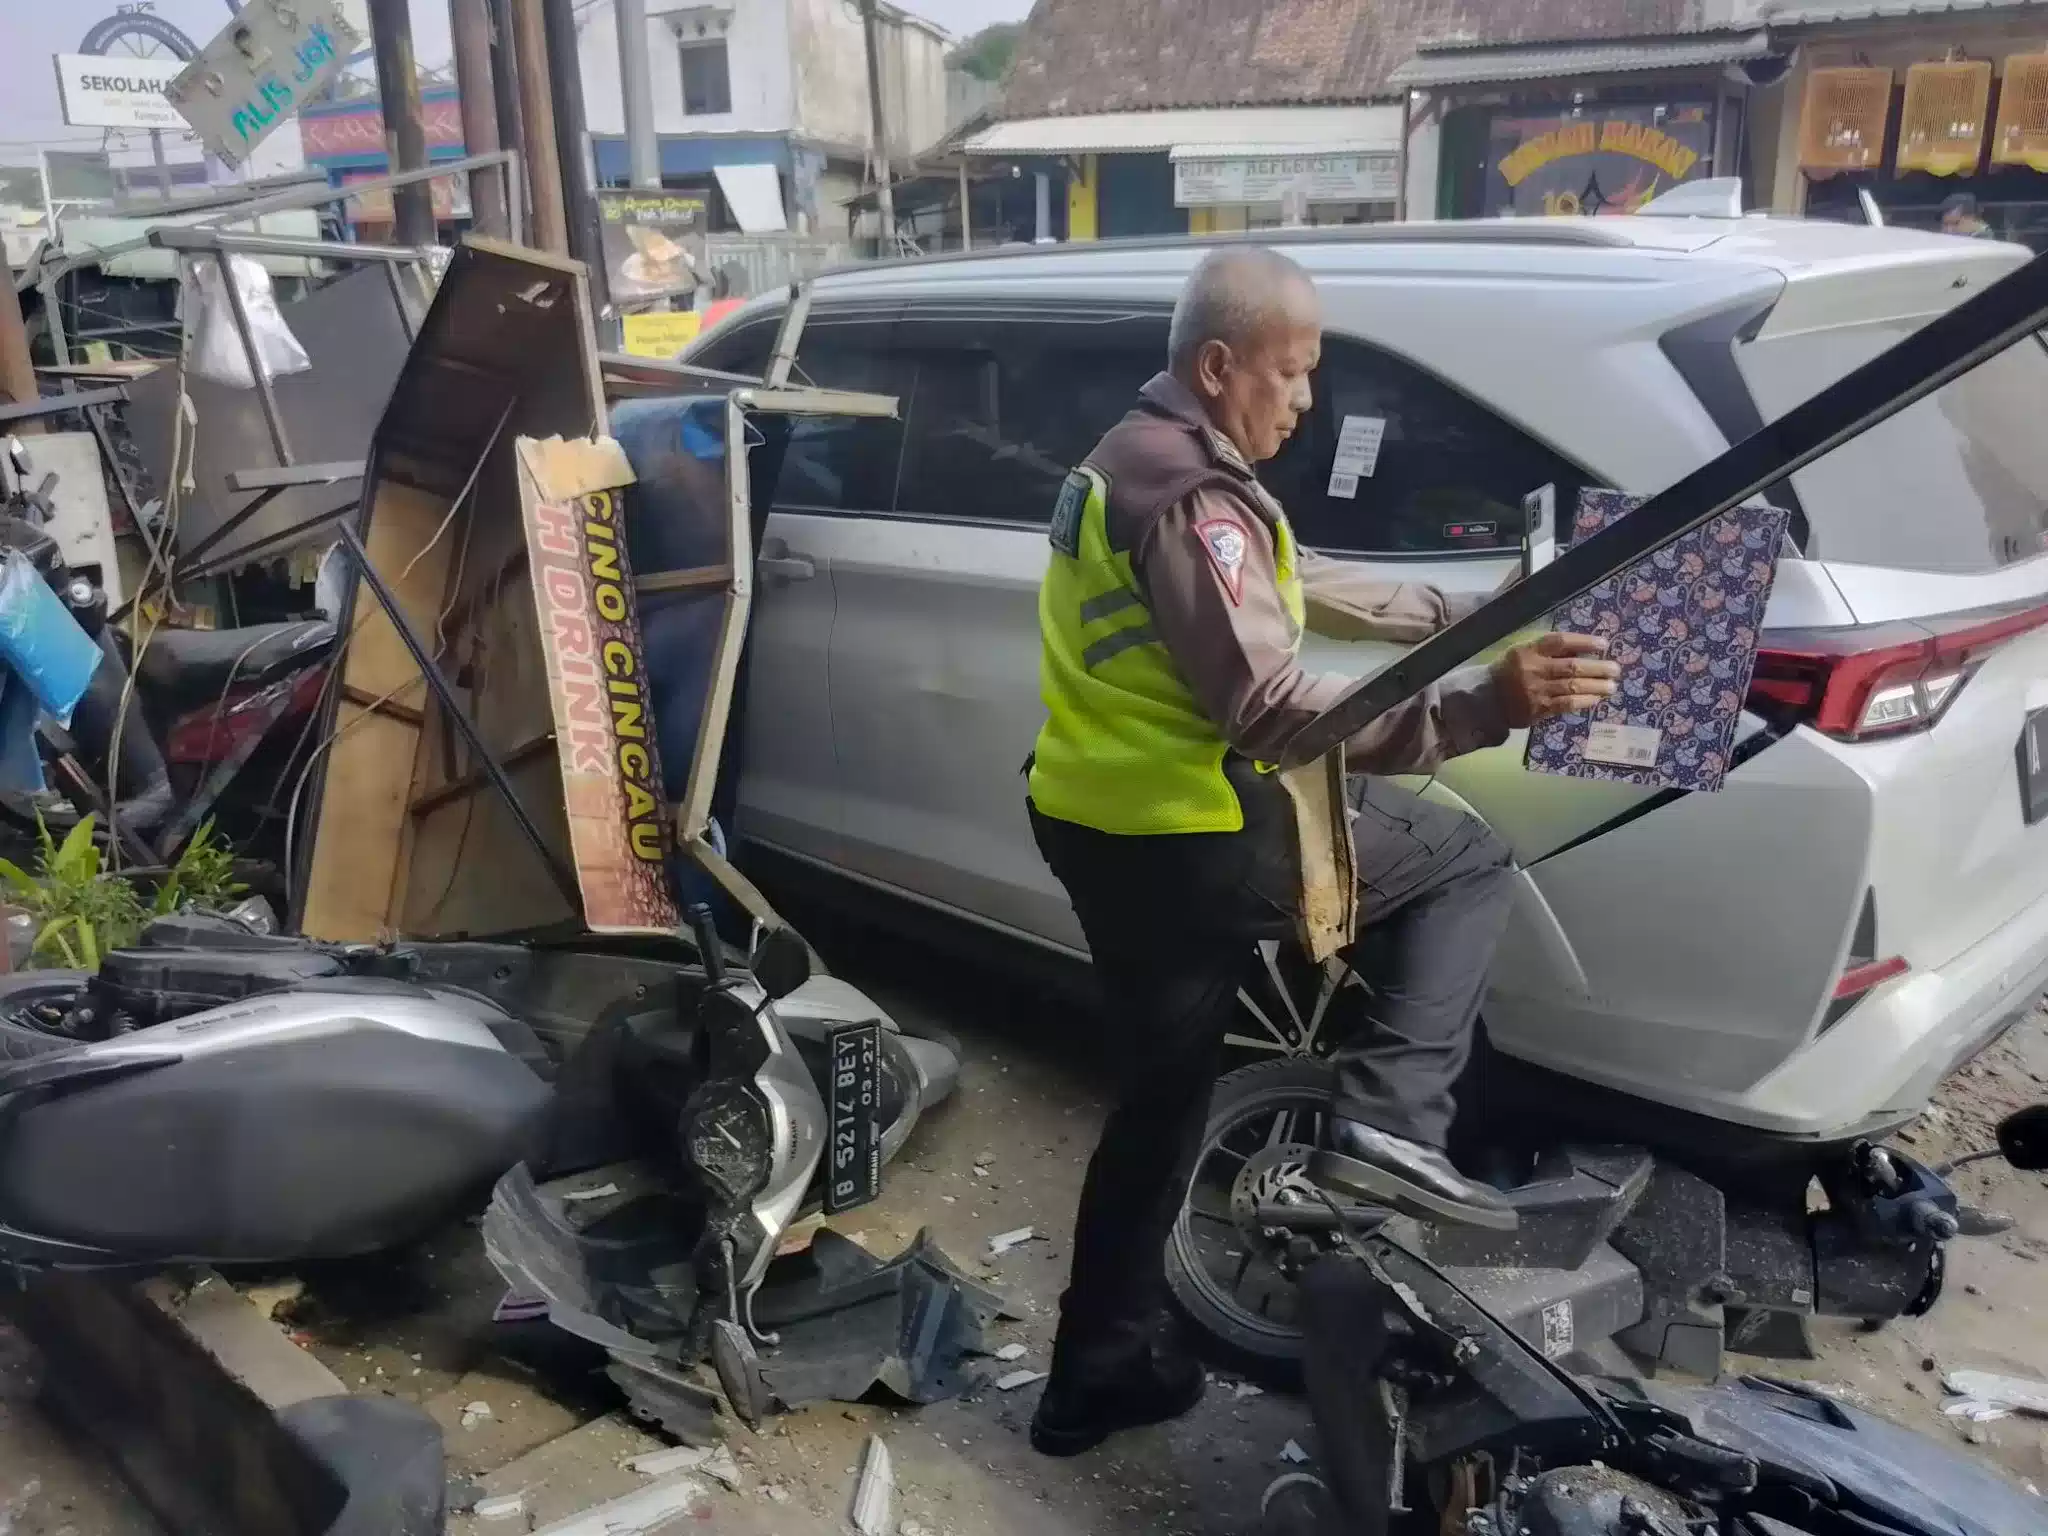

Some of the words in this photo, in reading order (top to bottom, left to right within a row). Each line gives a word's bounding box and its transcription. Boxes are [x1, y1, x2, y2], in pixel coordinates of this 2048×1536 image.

[543, 564, 613, 778] DRINK
[601, 638, 663, 862] CINCAU
[836, 1040, 858, 1089] BEY
[836, 1097, 857, 1169] 5214
[836, 1179, 855, 1197] B
